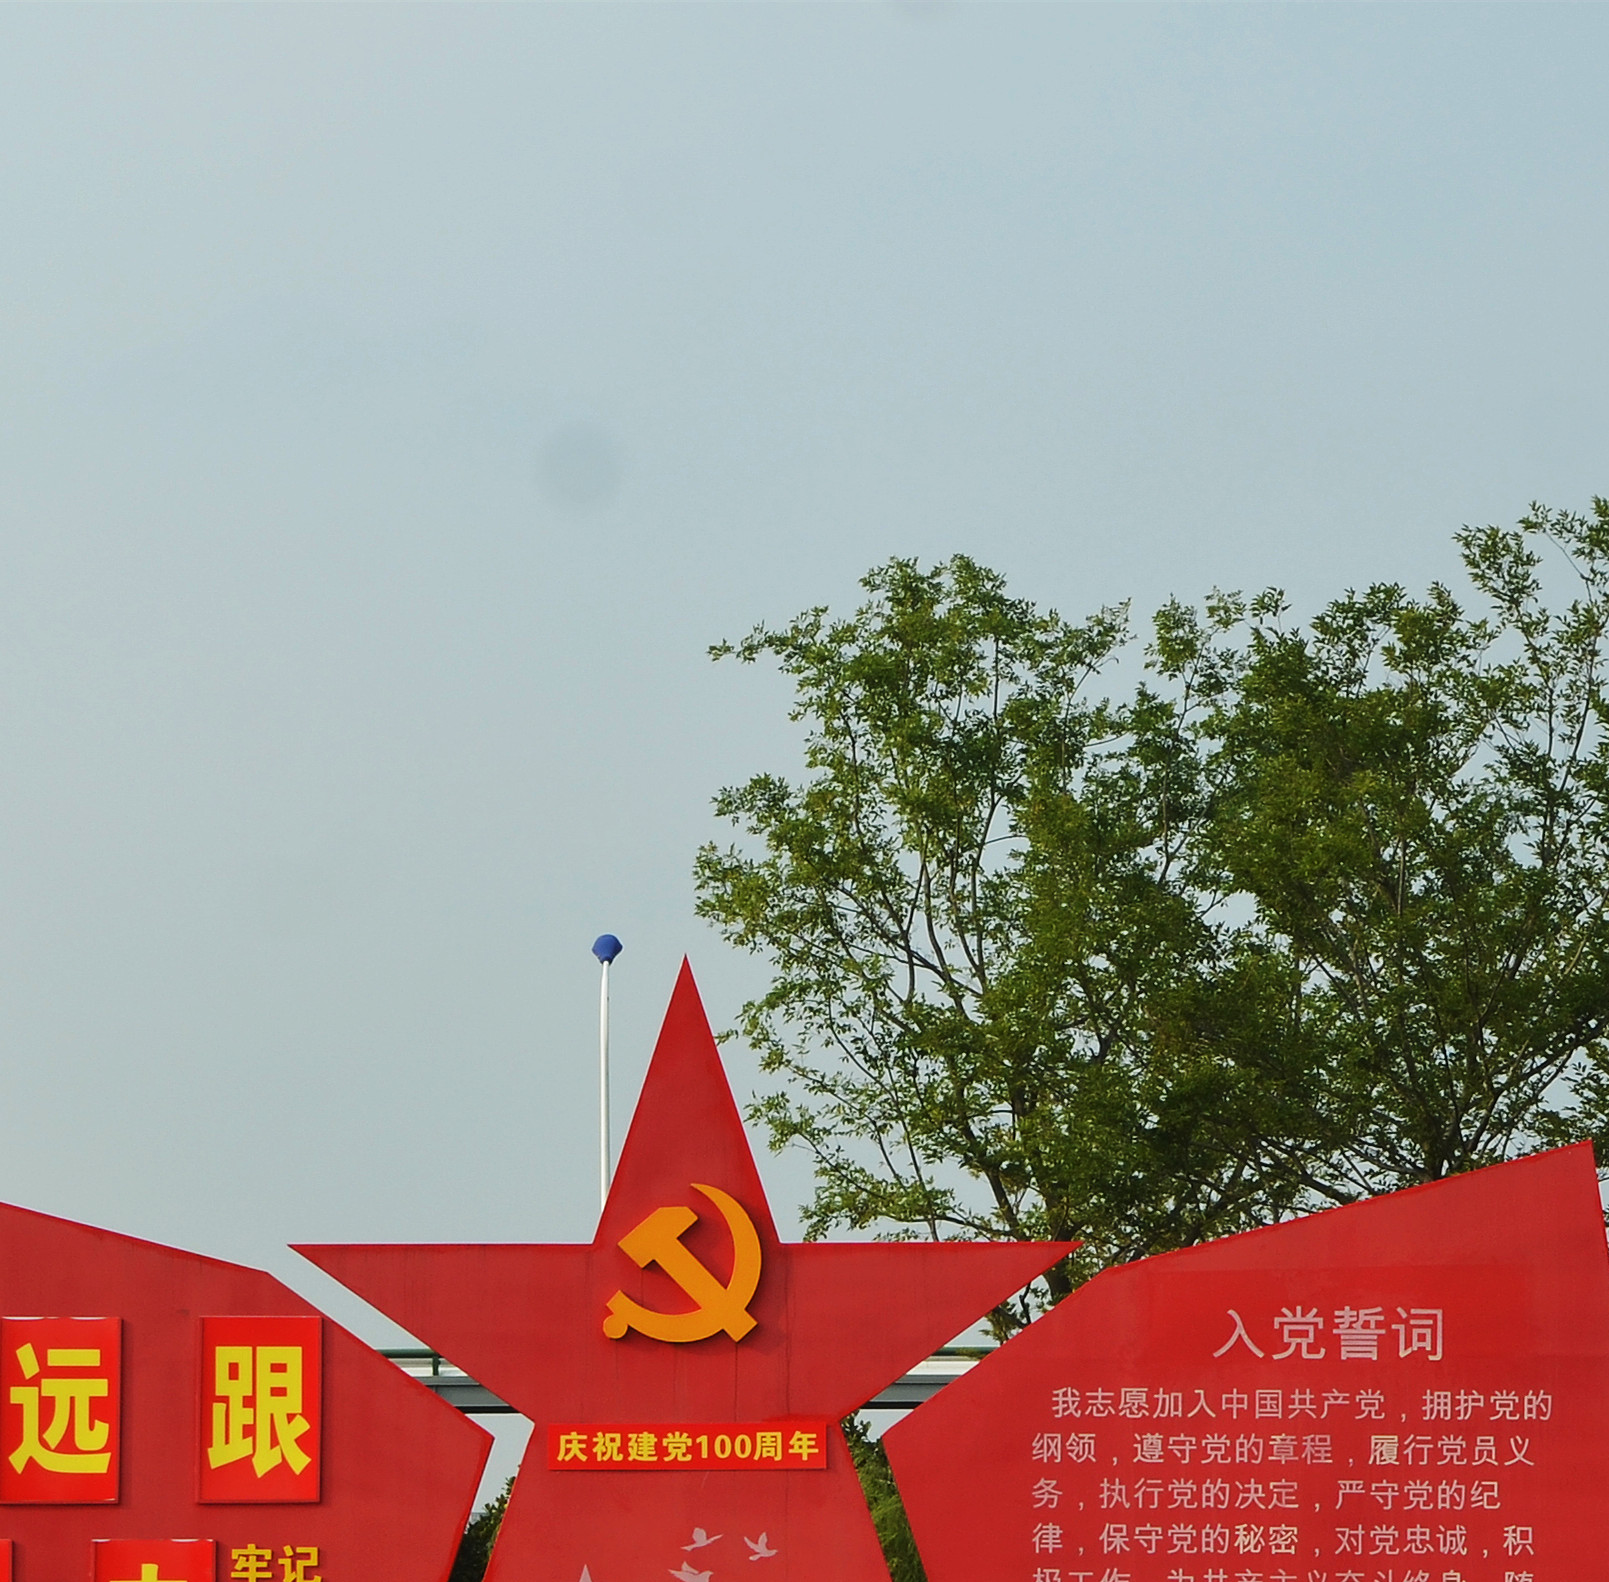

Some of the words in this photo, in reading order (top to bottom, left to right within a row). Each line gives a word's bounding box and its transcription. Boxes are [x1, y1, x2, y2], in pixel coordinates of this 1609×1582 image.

[1213, 1305, 1444, 1361] 入党誓词
[1052, 1386, 1553, 1423] 我志愿加入中国共产党，拥护党的
[557, 1430, 819, 1462] 庆祝建党100周年
